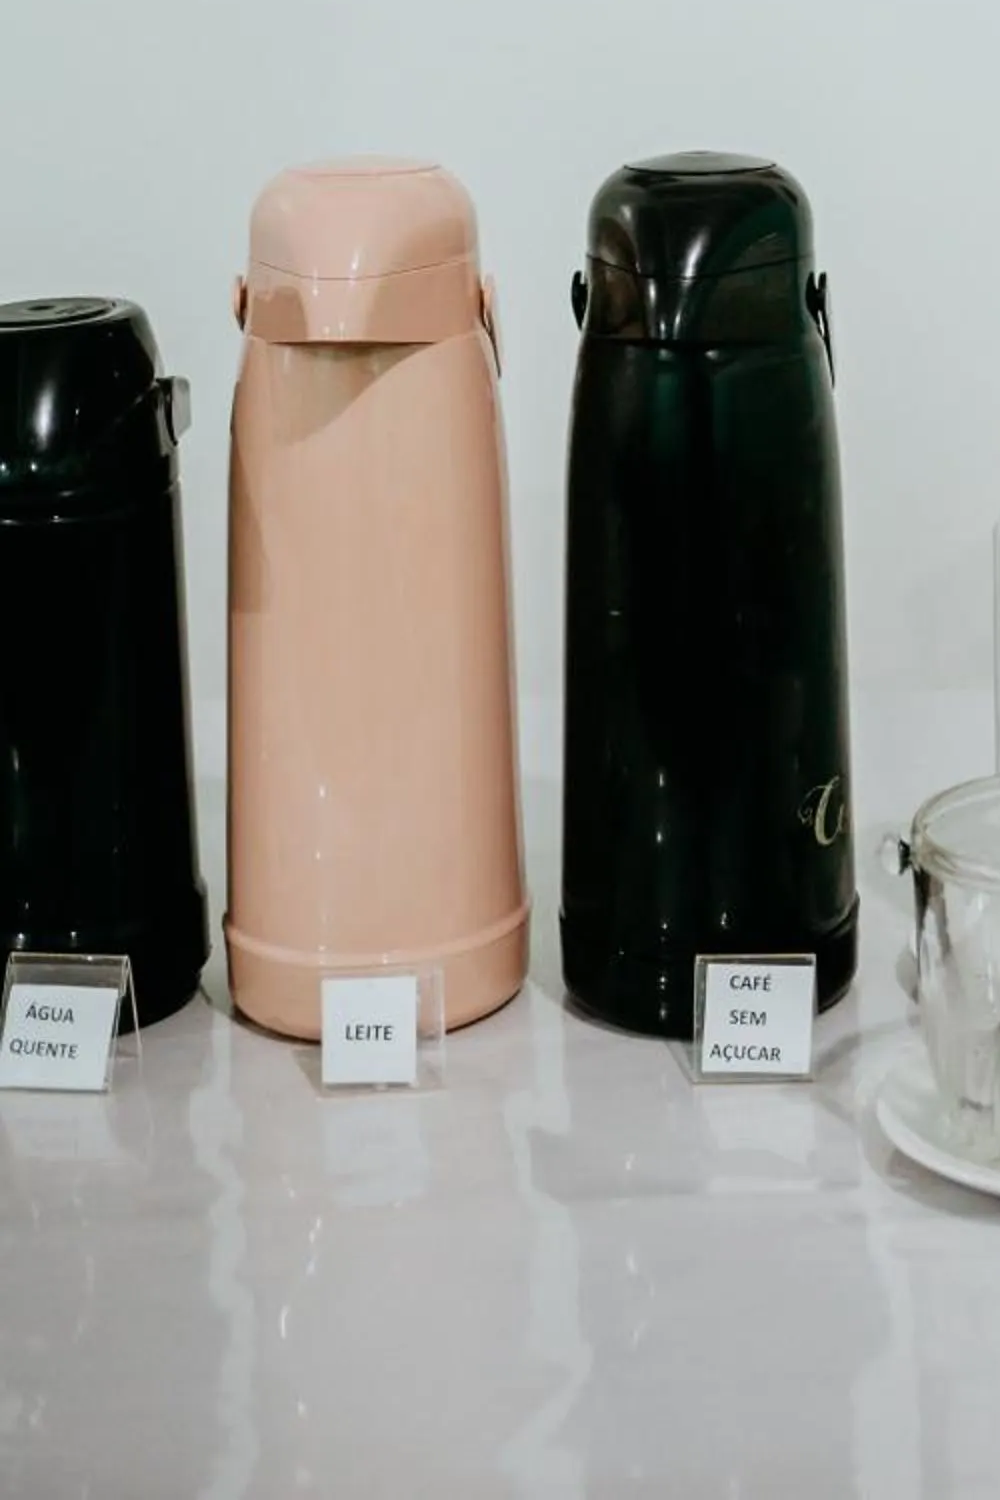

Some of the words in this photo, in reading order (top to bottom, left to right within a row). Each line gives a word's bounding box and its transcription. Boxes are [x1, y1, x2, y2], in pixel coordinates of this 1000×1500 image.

[729, 974, 772, 992] CAFÉ
[729, 1009, 767, 1026] SEM
[345, 1024, 394, 1041] LEITE
[9, 1038, 79, 1059] QUENTE
